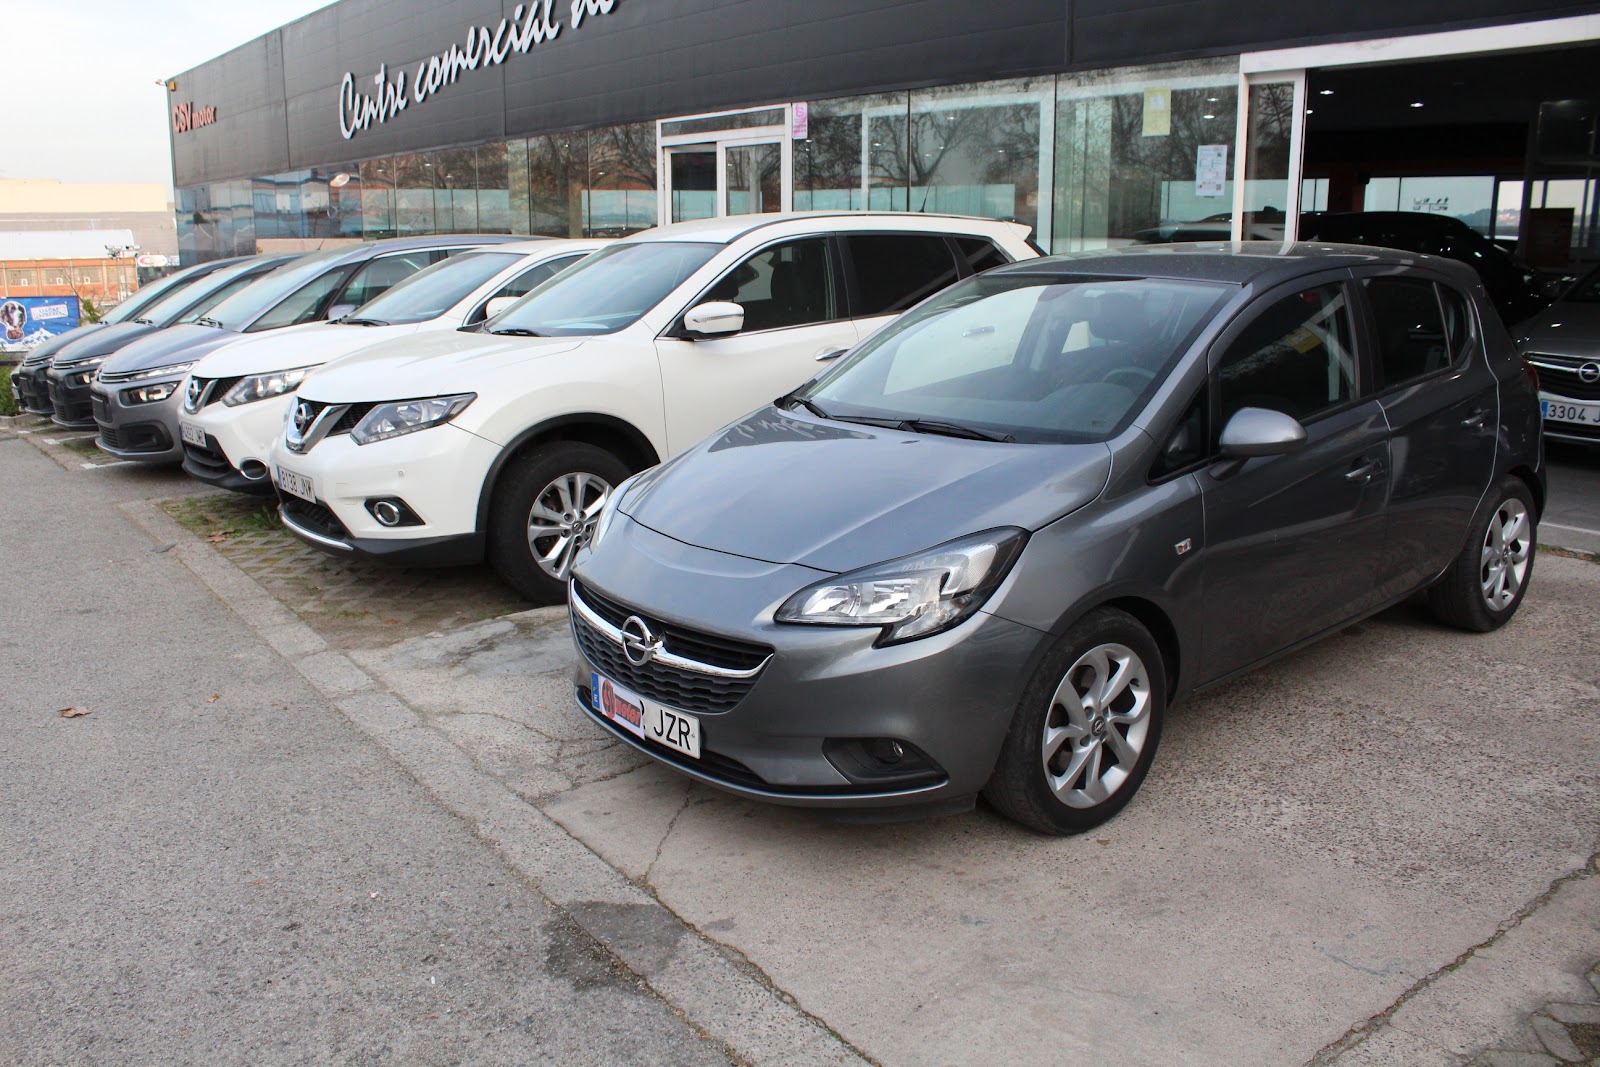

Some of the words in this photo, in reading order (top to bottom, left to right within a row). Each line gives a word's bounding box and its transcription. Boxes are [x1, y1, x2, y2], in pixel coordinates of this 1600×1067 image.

[339, 63, 408, 140] Centre
[414, 0, 560, 103] comercial
[191, 105, 216, 129] motor
[1548, 404, 1586, 421] 3304
[614, 697, 641, 726] motor
[653, 708, 691, 751] JZR
